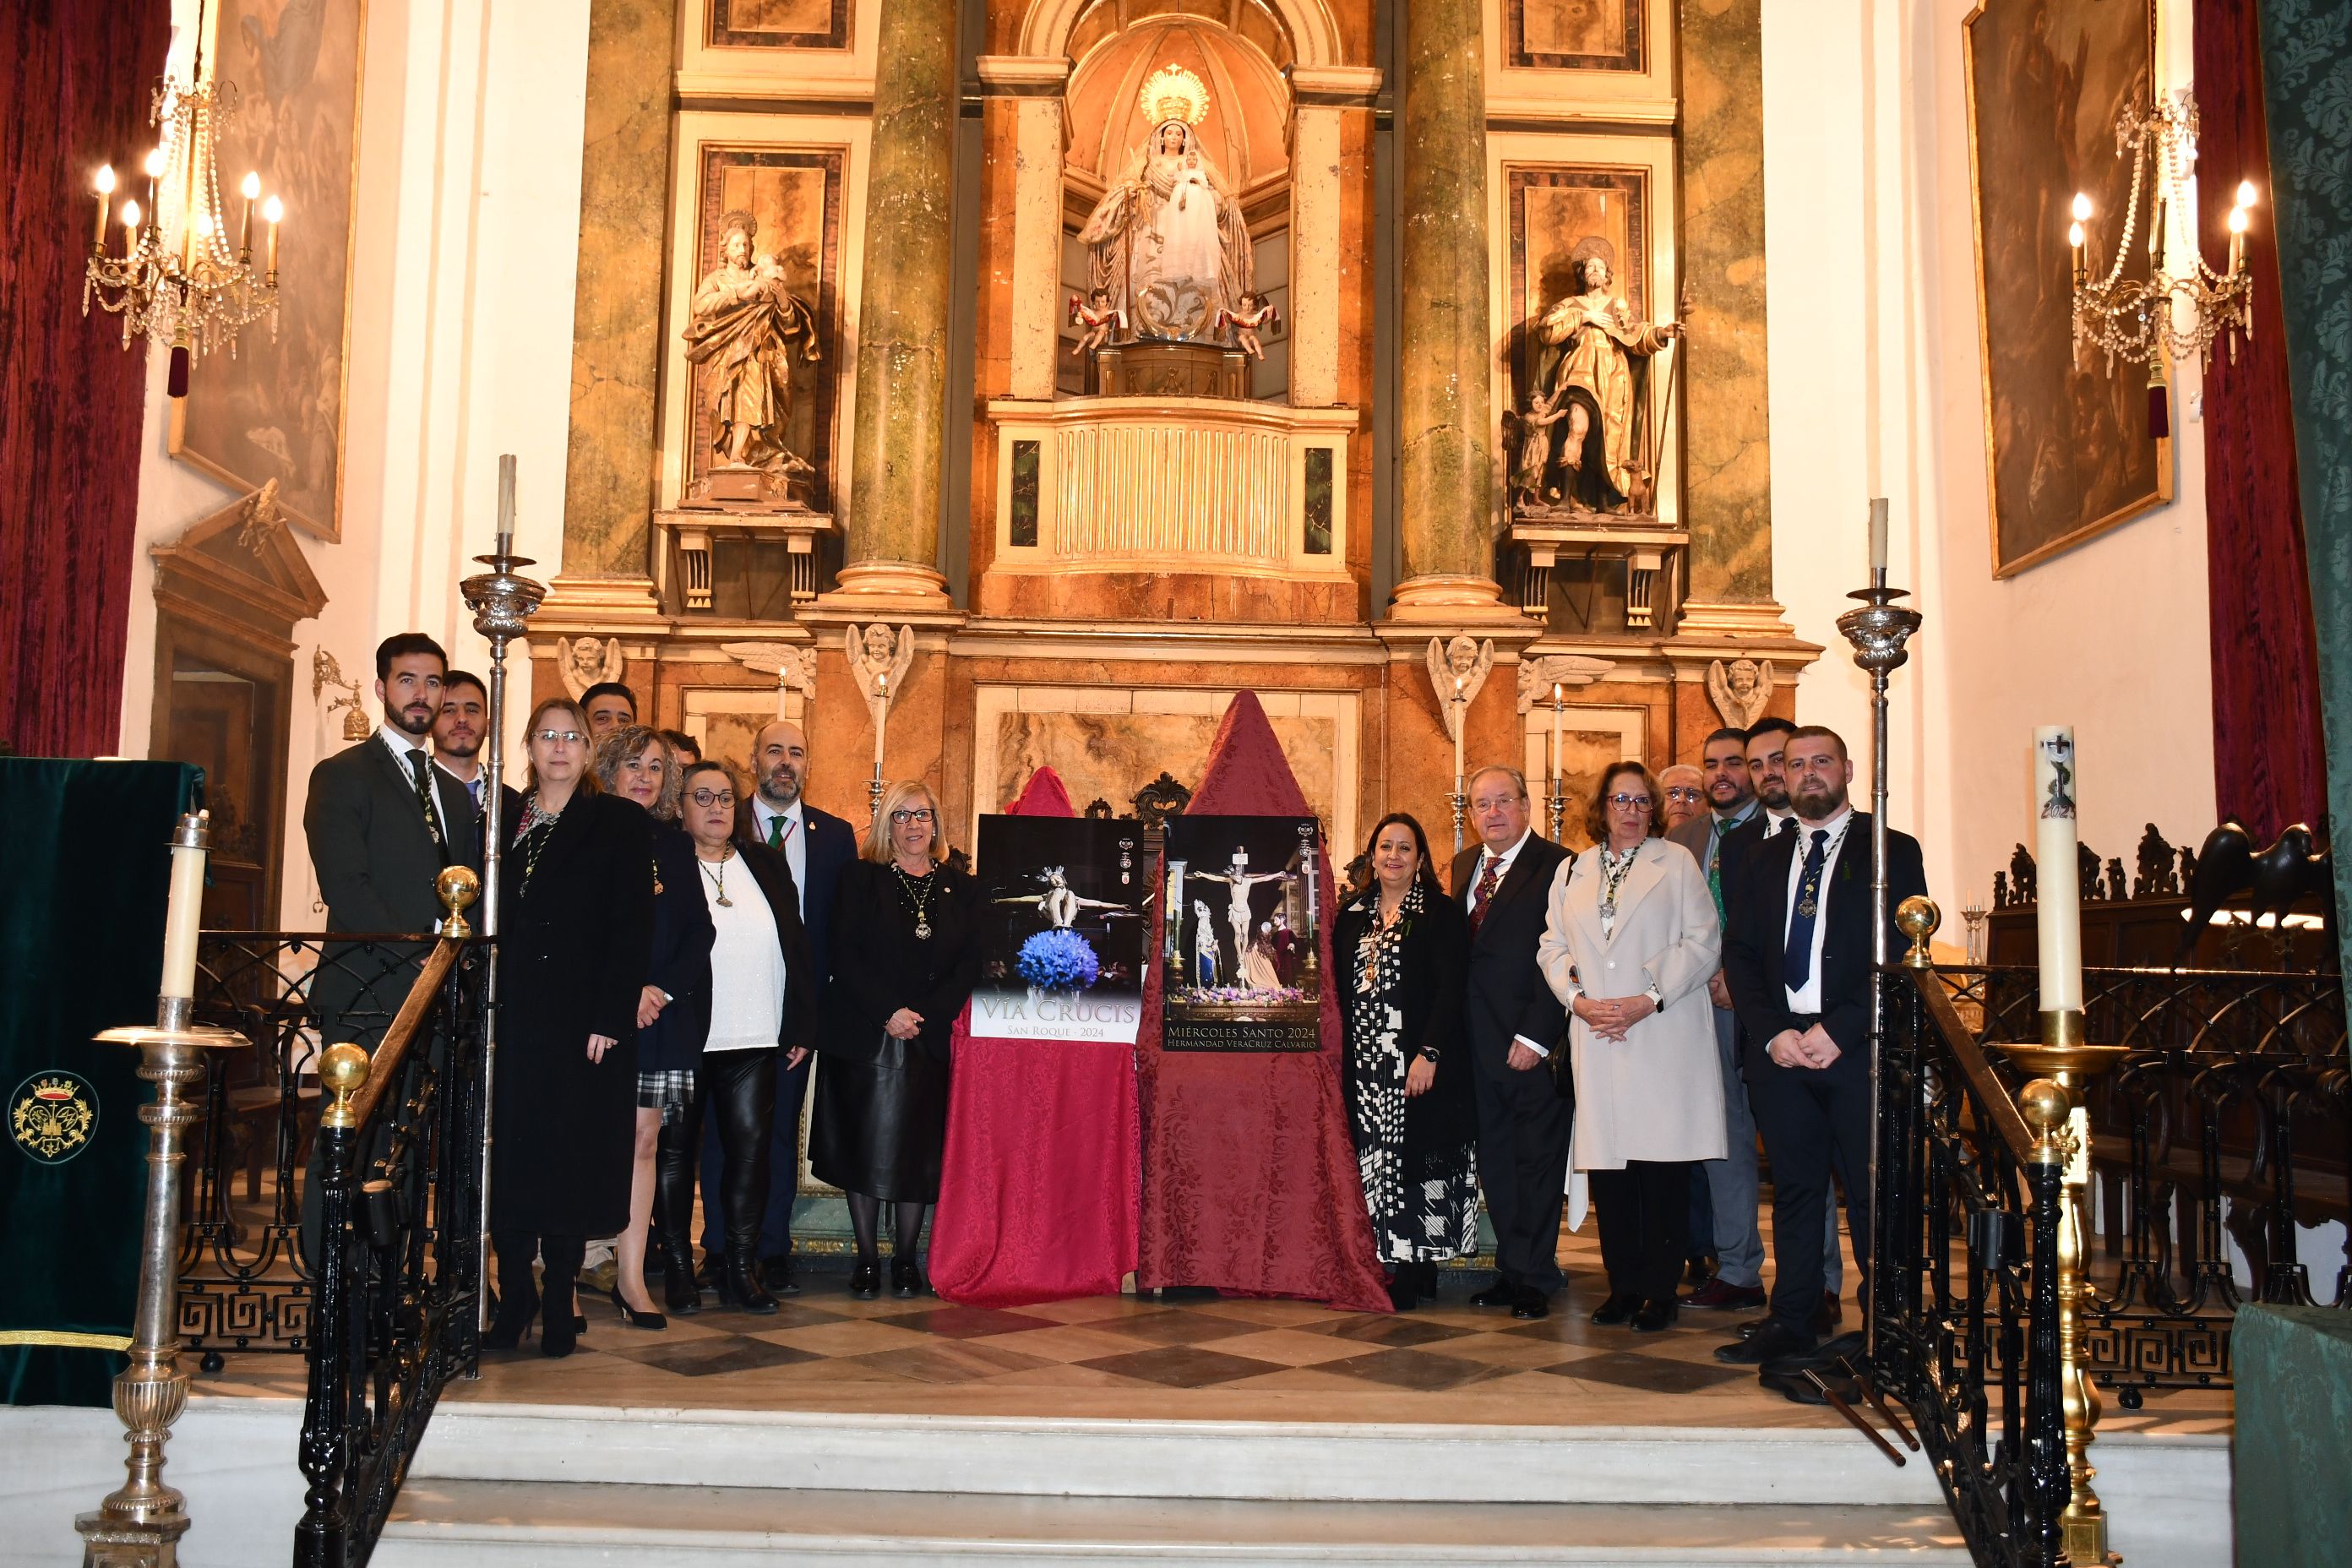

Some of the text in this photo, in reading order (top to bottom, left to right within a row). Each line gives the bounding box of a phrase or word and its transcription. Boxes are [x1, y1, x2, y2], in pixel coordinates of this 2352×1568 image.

[982, 997, 1135, 1024] VÍA CRUCIS
[1007, 1025, 1028, 1035] SAN
[1033, 1026, 1070, 1037] ROQUE
[1081, 1027, 1103, 1037] 2024
[1168, 1026, 1315, 1039] MIÉRCOLES SANTO 2024
[1168, 1039, 1223, 1048] HERMANDAD
[1274, 1040, 1316, 1048] CALVARIO
